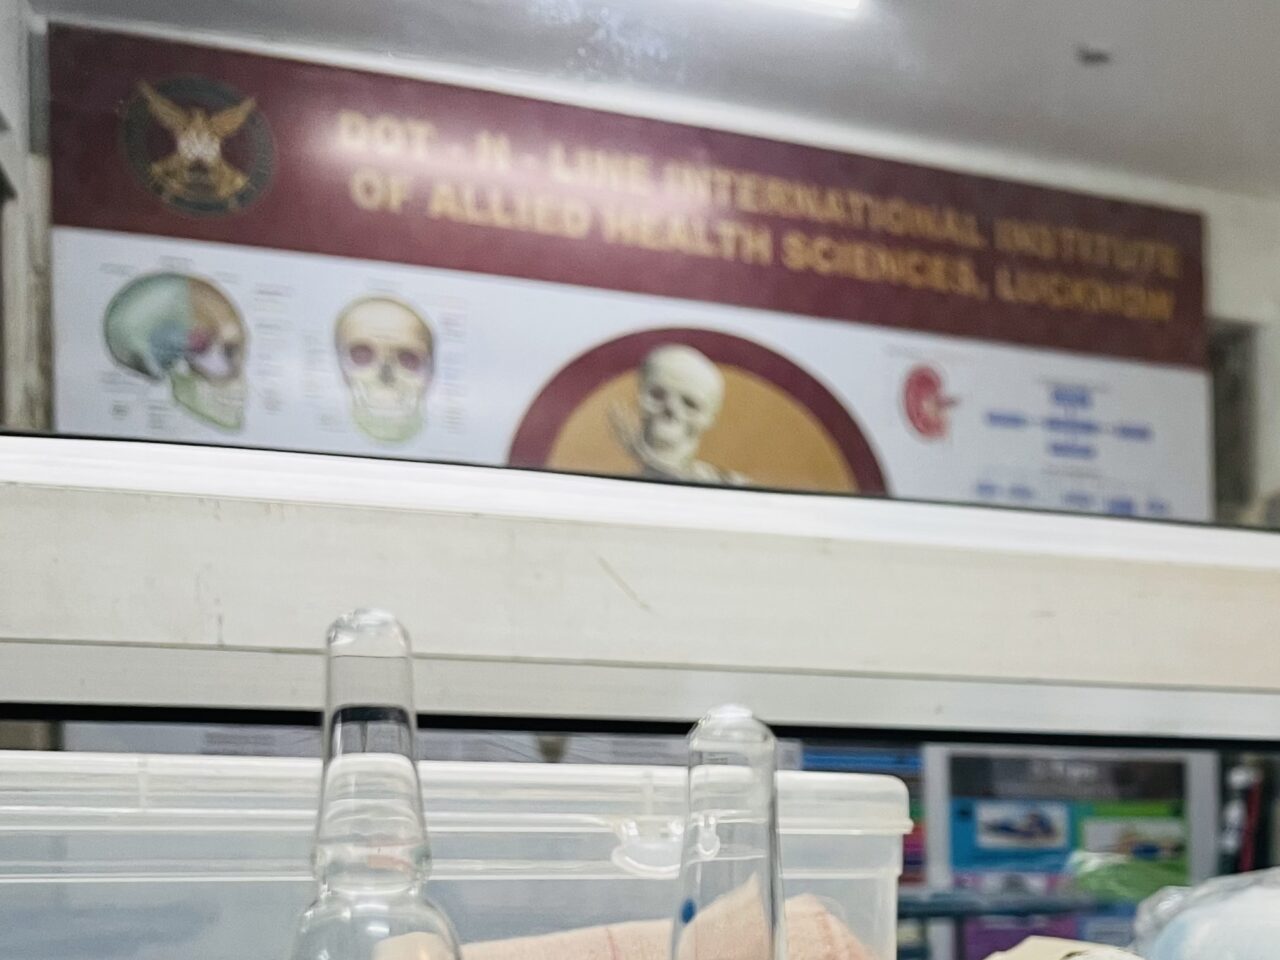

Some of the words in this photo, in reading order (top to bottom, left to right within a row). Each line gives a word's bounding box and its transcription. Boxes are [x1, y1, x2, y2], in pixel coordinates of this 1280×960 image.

[349, 166, 411, 214] OF
[427, 179, 592, 241] ALLIED
[601, 207, 773, 267] HEALTH
[661, 160, 988, 250] INTERNATIONAL
[994, 216, 1180, 280] INSTITUTE
